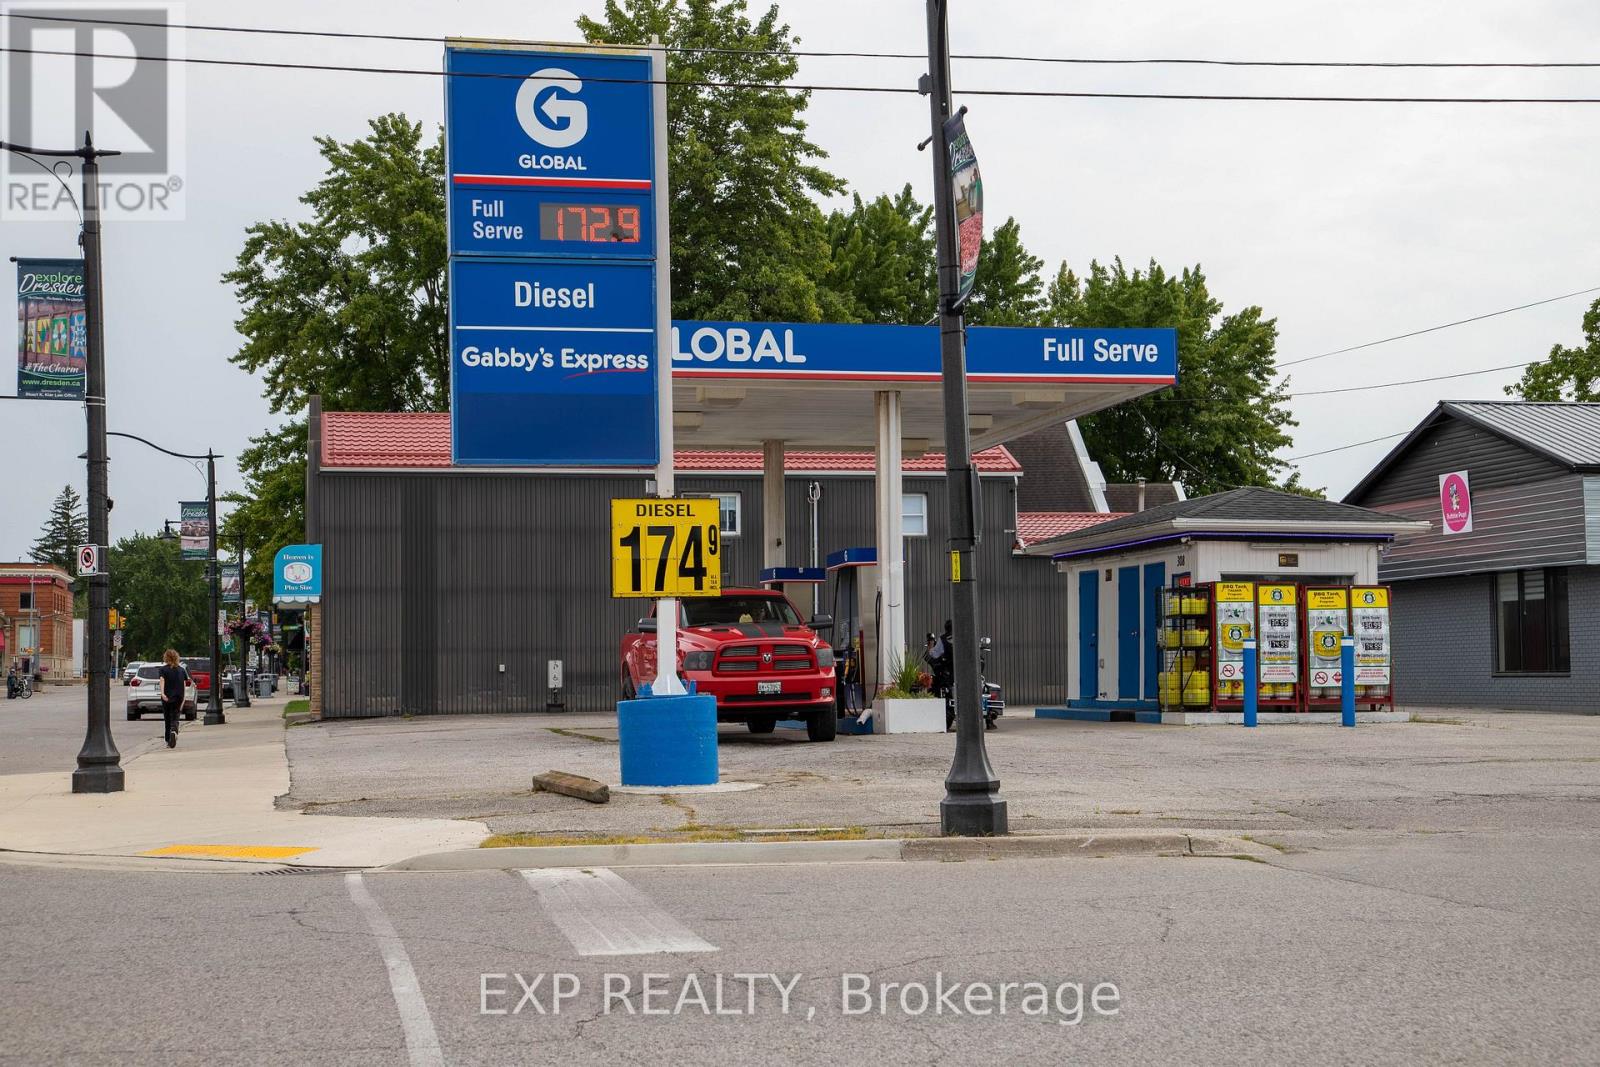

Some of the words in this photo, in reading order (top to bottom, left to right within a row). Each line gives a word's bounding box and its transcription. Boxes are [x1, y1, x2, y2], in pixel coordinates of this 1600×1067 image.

[518, 154, 587, 170] GLOBAL
[472, 200, 504, 217] Full
[473, 221, 523, 240] Serve
[19, 273, 84, 295] Dresden
[35, 272, 82, 284] explore
[514, 281, 594, 308] Diesel
[672, 327, 807, 363] LOBAL
[1043, 338, 1084, 361] Full
[1093, 338, 1158, 362] Serve
[25, 362, 79, 373] #TheCharm
[461, 346, 554, 372] Gabby's
[561, 348, 649, 372] Express
[22, 379, 81, 387] www.dresden.ca
[636, 504, 696, 517] DIESEL
